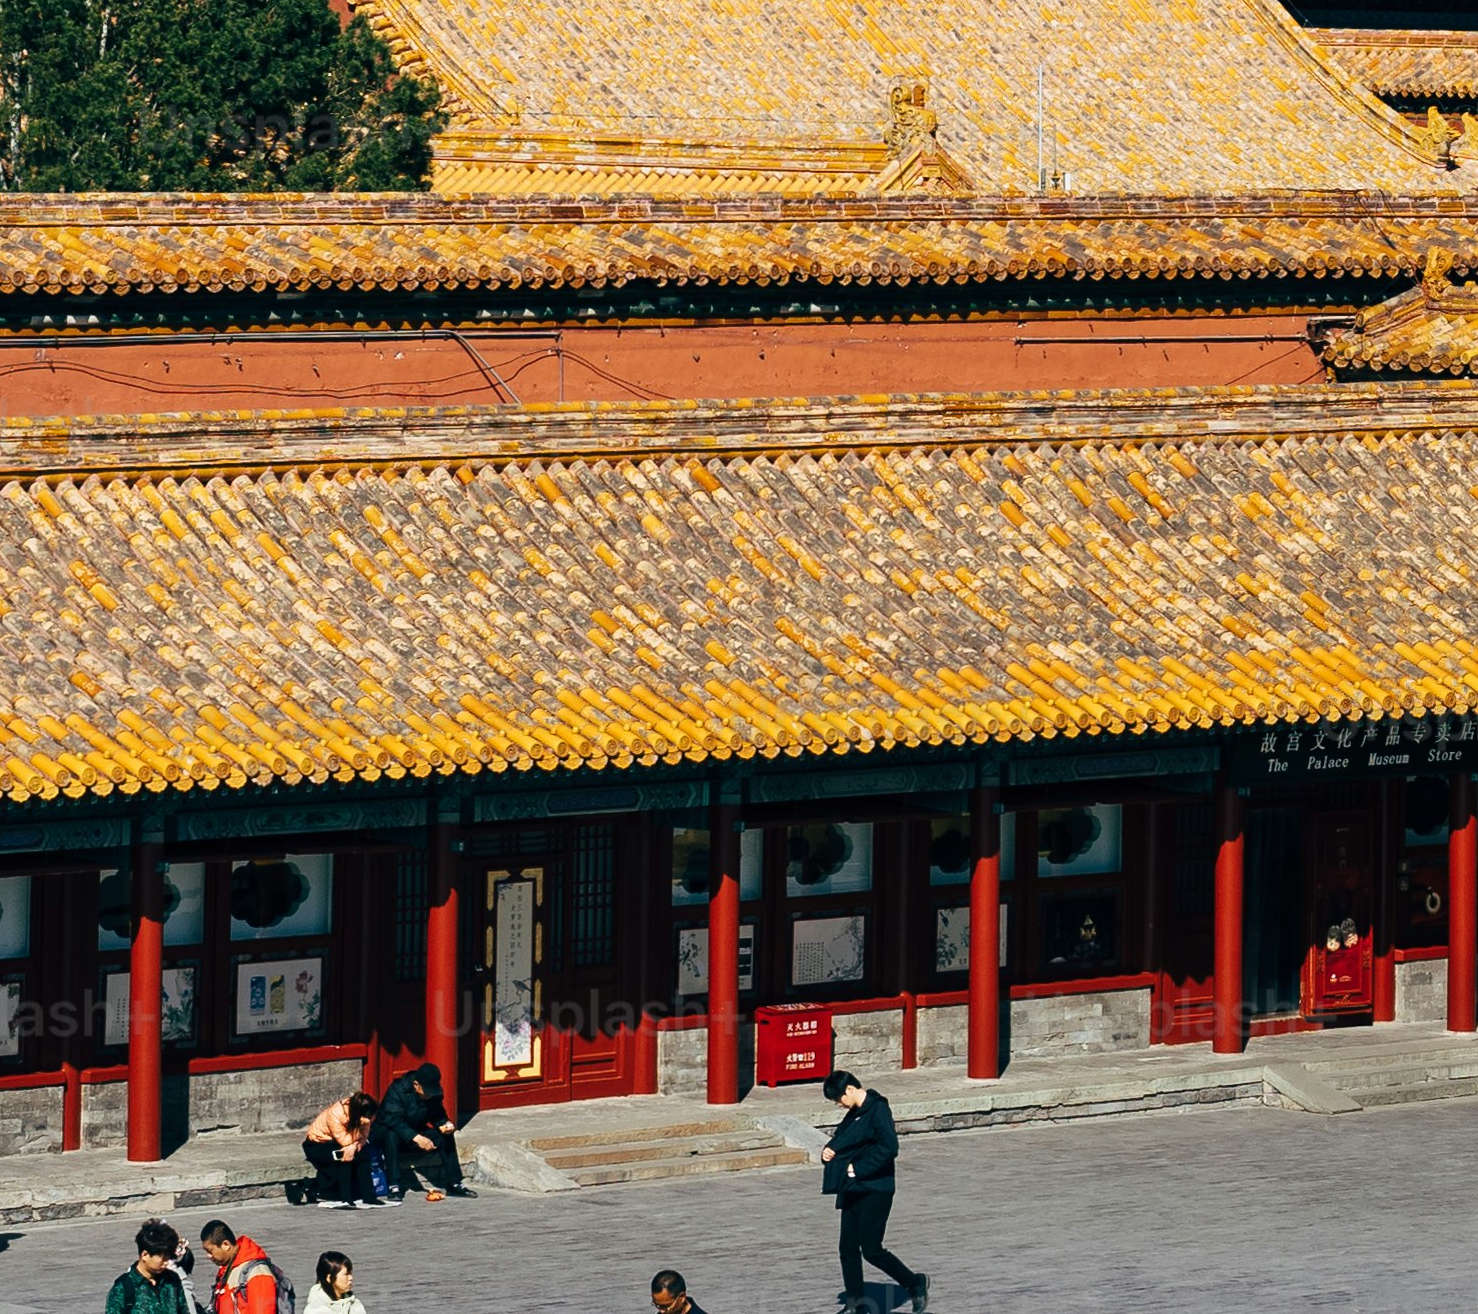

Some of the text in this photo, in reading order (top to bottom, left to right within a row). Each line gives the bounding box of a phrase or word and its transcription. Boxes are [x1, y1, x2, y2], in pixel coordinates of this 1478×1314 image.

[1260, 721, 1476, 753] 故宫文化产品专卖店
[1268, 748, 1462, 772] The Palace Museum Store
